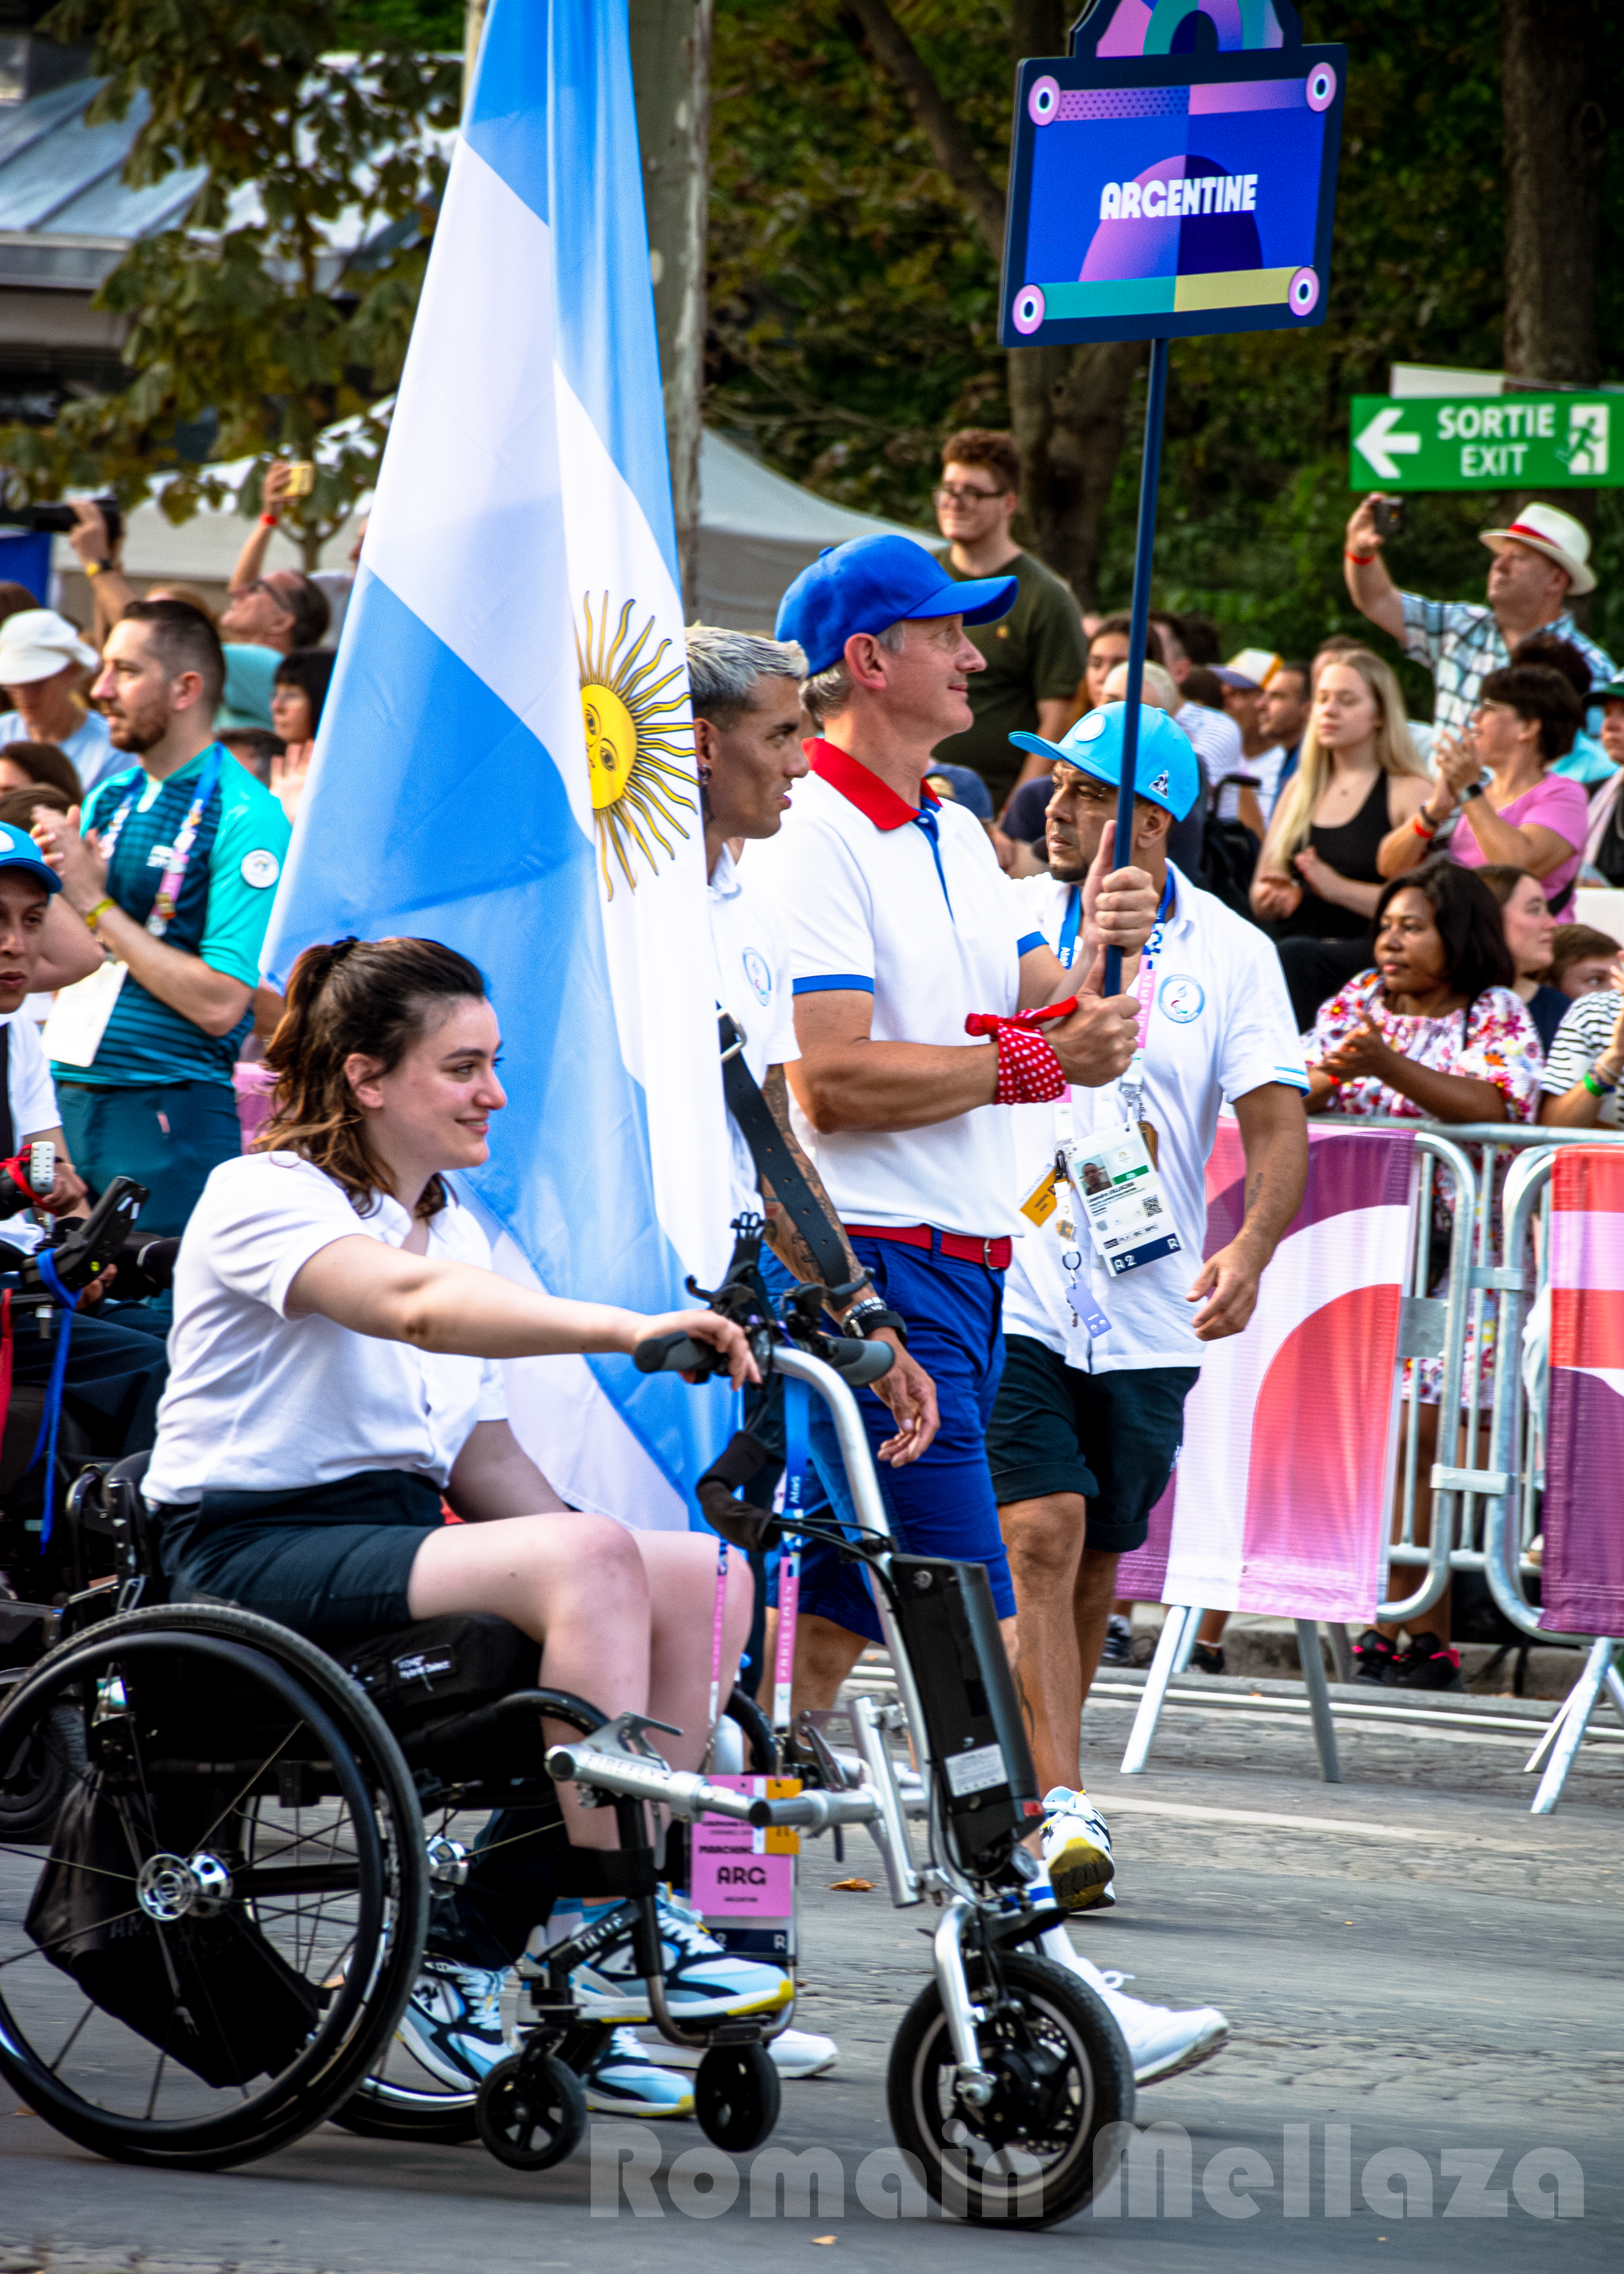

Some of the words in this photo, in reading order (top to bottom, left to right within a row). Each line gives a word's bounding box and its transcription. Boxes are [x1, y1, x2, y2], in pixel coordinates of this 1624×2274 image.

[1100, 174, 1258, 219] ARGENTINE
[1437, 404, 1555, 439] SORTIE
[1461, 444, 1528, 476] EXIT
[1166, 1237, 1180, 1250] R
[1114, 1255, 1137, 1270] A2
[717, 1866, 766, 1885] ARG
[773, 1934, 786, 1950] R
